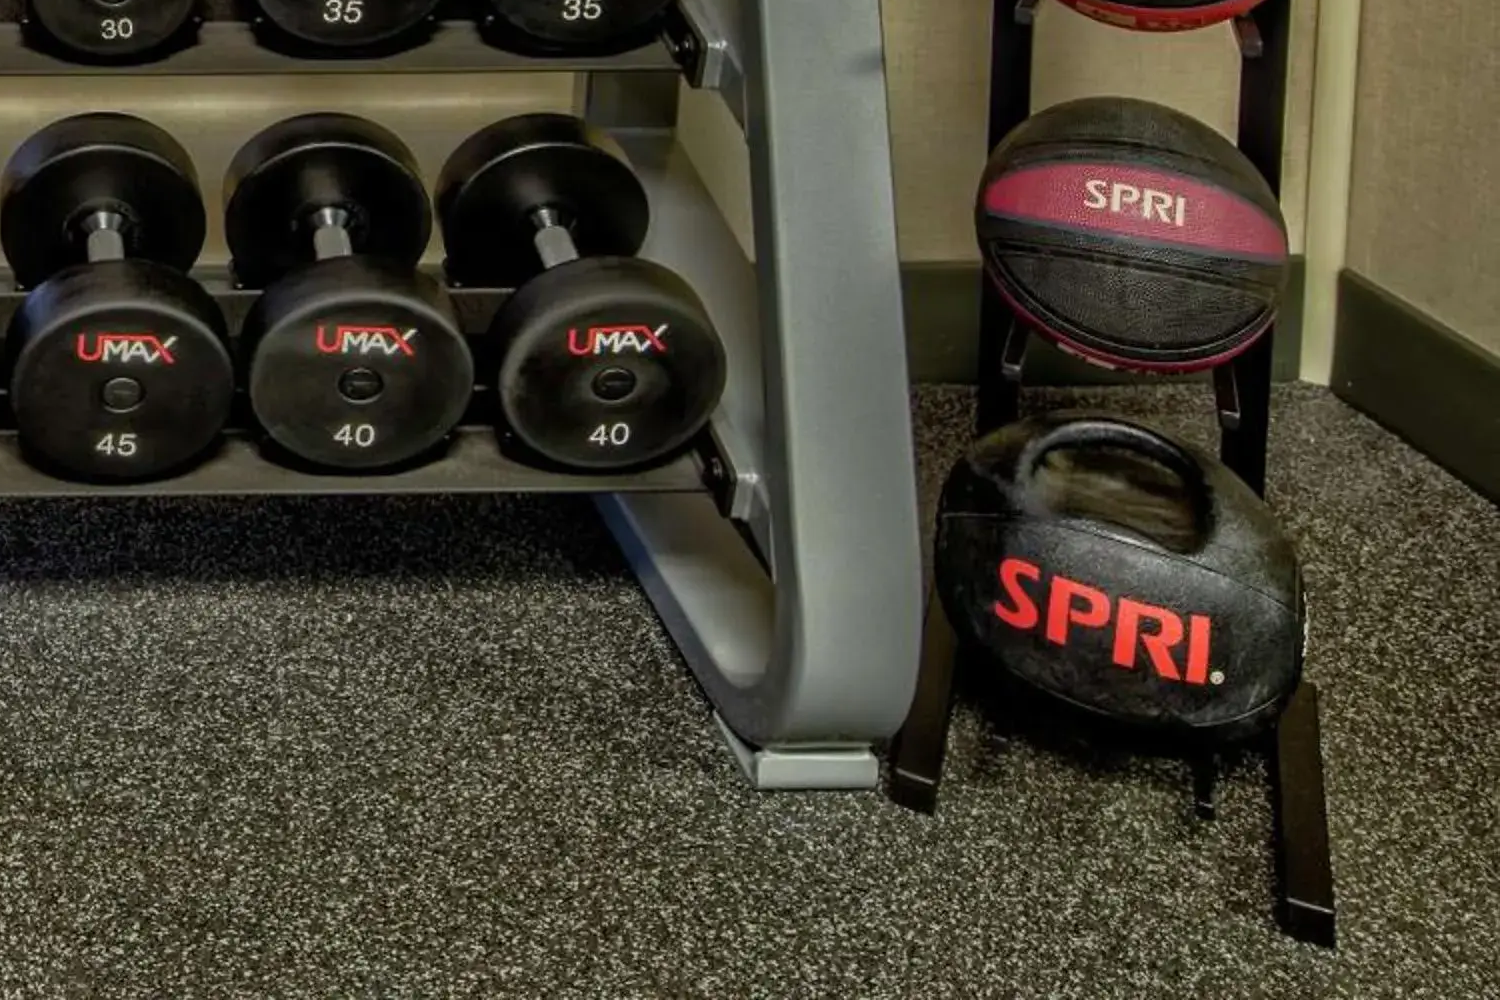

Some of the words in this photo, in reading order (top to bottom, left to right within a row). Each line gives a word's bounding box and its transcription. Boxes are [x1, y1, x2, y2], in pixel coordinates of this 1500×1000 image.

[101, 17, 133, 40] 30
[1083, 179, 1187, 228] SPRI
[76, 332, 177, 364] UMAX
[314, 324, 417, 356] UMAX
[567, 324, 668, 356] UMAX
[96, 433, 137, 457] 45
[333, 423, 376, 447] 40
[588, 422, 630, 446] 40
[994, 556, 1212, 686] SPRI
